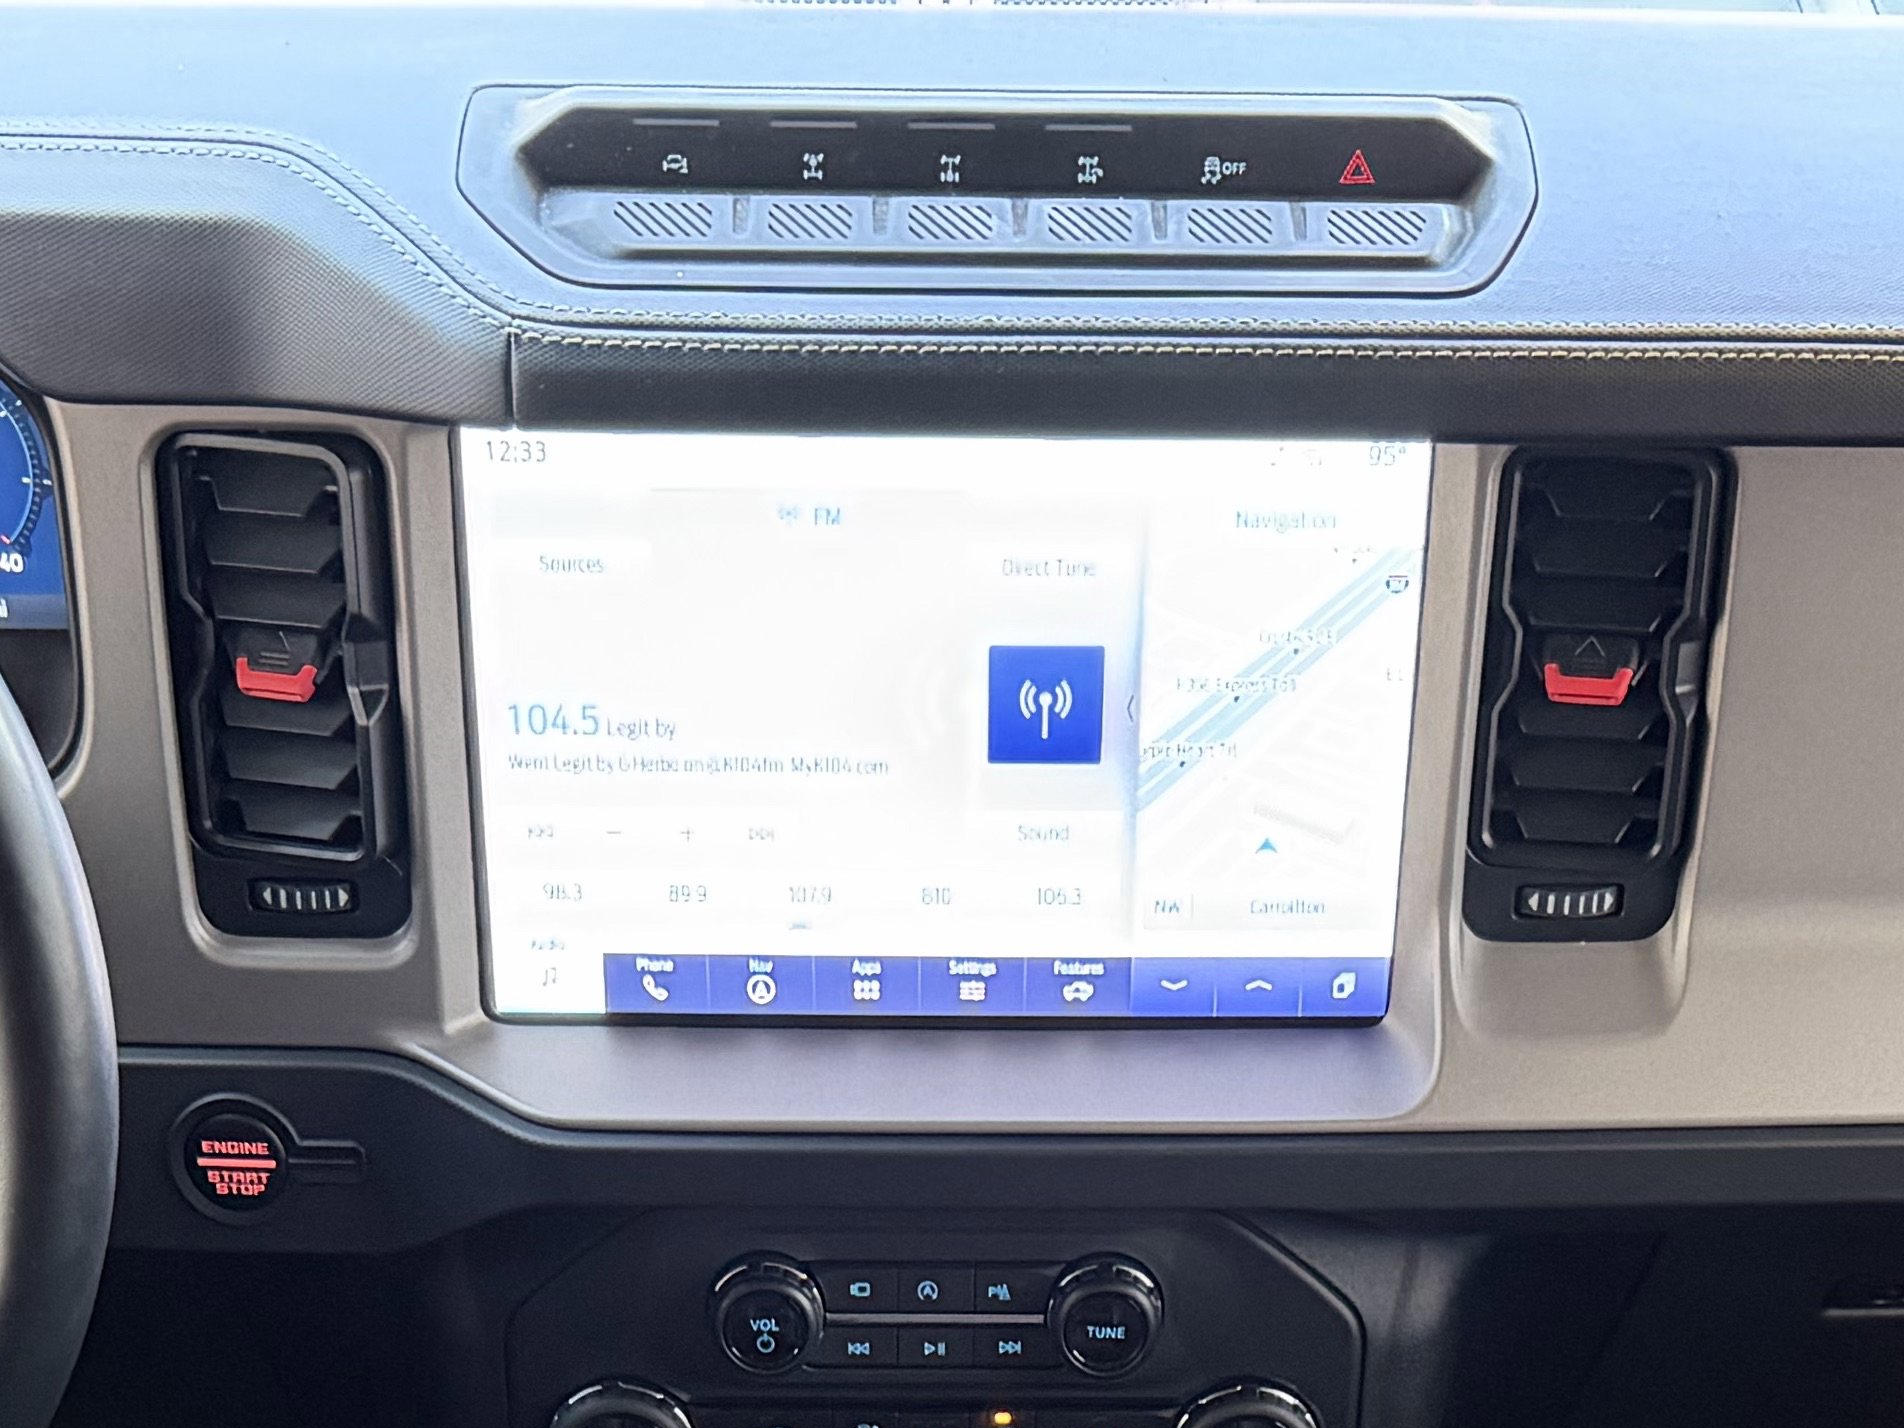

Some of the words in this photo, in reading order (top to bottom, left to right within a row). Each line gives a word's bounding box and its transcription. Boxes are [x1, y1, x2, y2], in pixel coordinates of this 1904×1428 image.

[1222, 161, 1247, 175] OFF
[486, 440, 547, 463] 12:33
[1235, 509, 1338, 535] Navigation
[538, 554, 606, 575] Sources
[508, 703, 601, 737] 104.5
[607, 717, 649, 740] Legit
[655, 719, 678, 740] by
[1017, 824, 1071, 843] Sound
[636, 958, 674, 974] Phone
[749, 958, 773, 973] Nav
[852, 960, 882, 977] Apps
[949, 960, 998, 977] Settings
[1053, 961, 1105, 977] Features
[201, 1140, 270, 1155] ENGINE
[207, 1170, 271, 1185] START
[215, 1183, 266, 1196] STOP
[750, 1318, 780, 1332] VOL
[1087, 1325, 1126, 1340] TUNE
